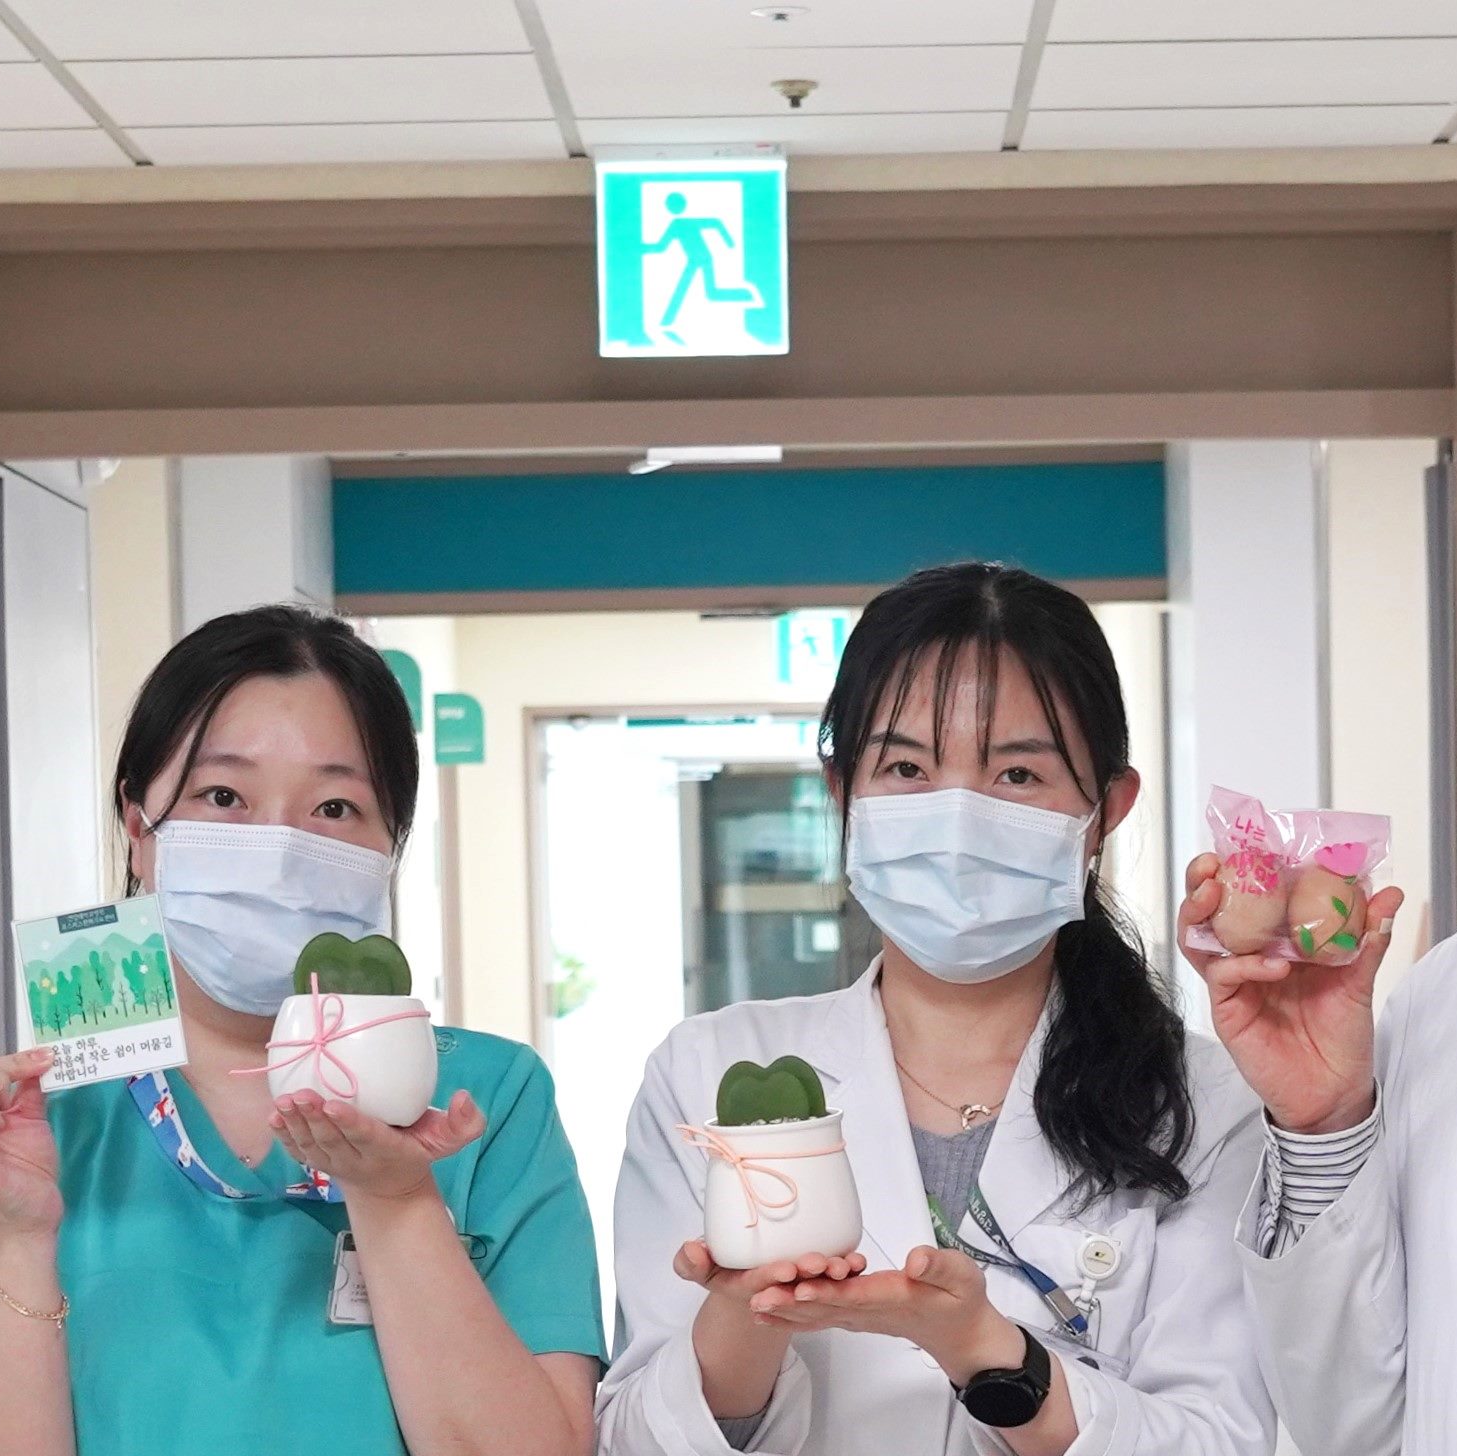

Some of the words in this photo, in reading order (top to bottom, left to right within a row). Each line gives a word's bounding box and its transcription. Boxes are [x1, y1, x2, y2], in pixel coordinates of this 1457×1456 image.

[1235, 816, 1265, 842] 나는
[52, 1043, 72, 1055] 오늘
[52, 1053, 85, 1068] 마음에
[89, 1047, 110, 1061] 작은
[114, 1043, 136, 1058] 쉼이
[54, 1064, 98, 1082] 바랍니다
